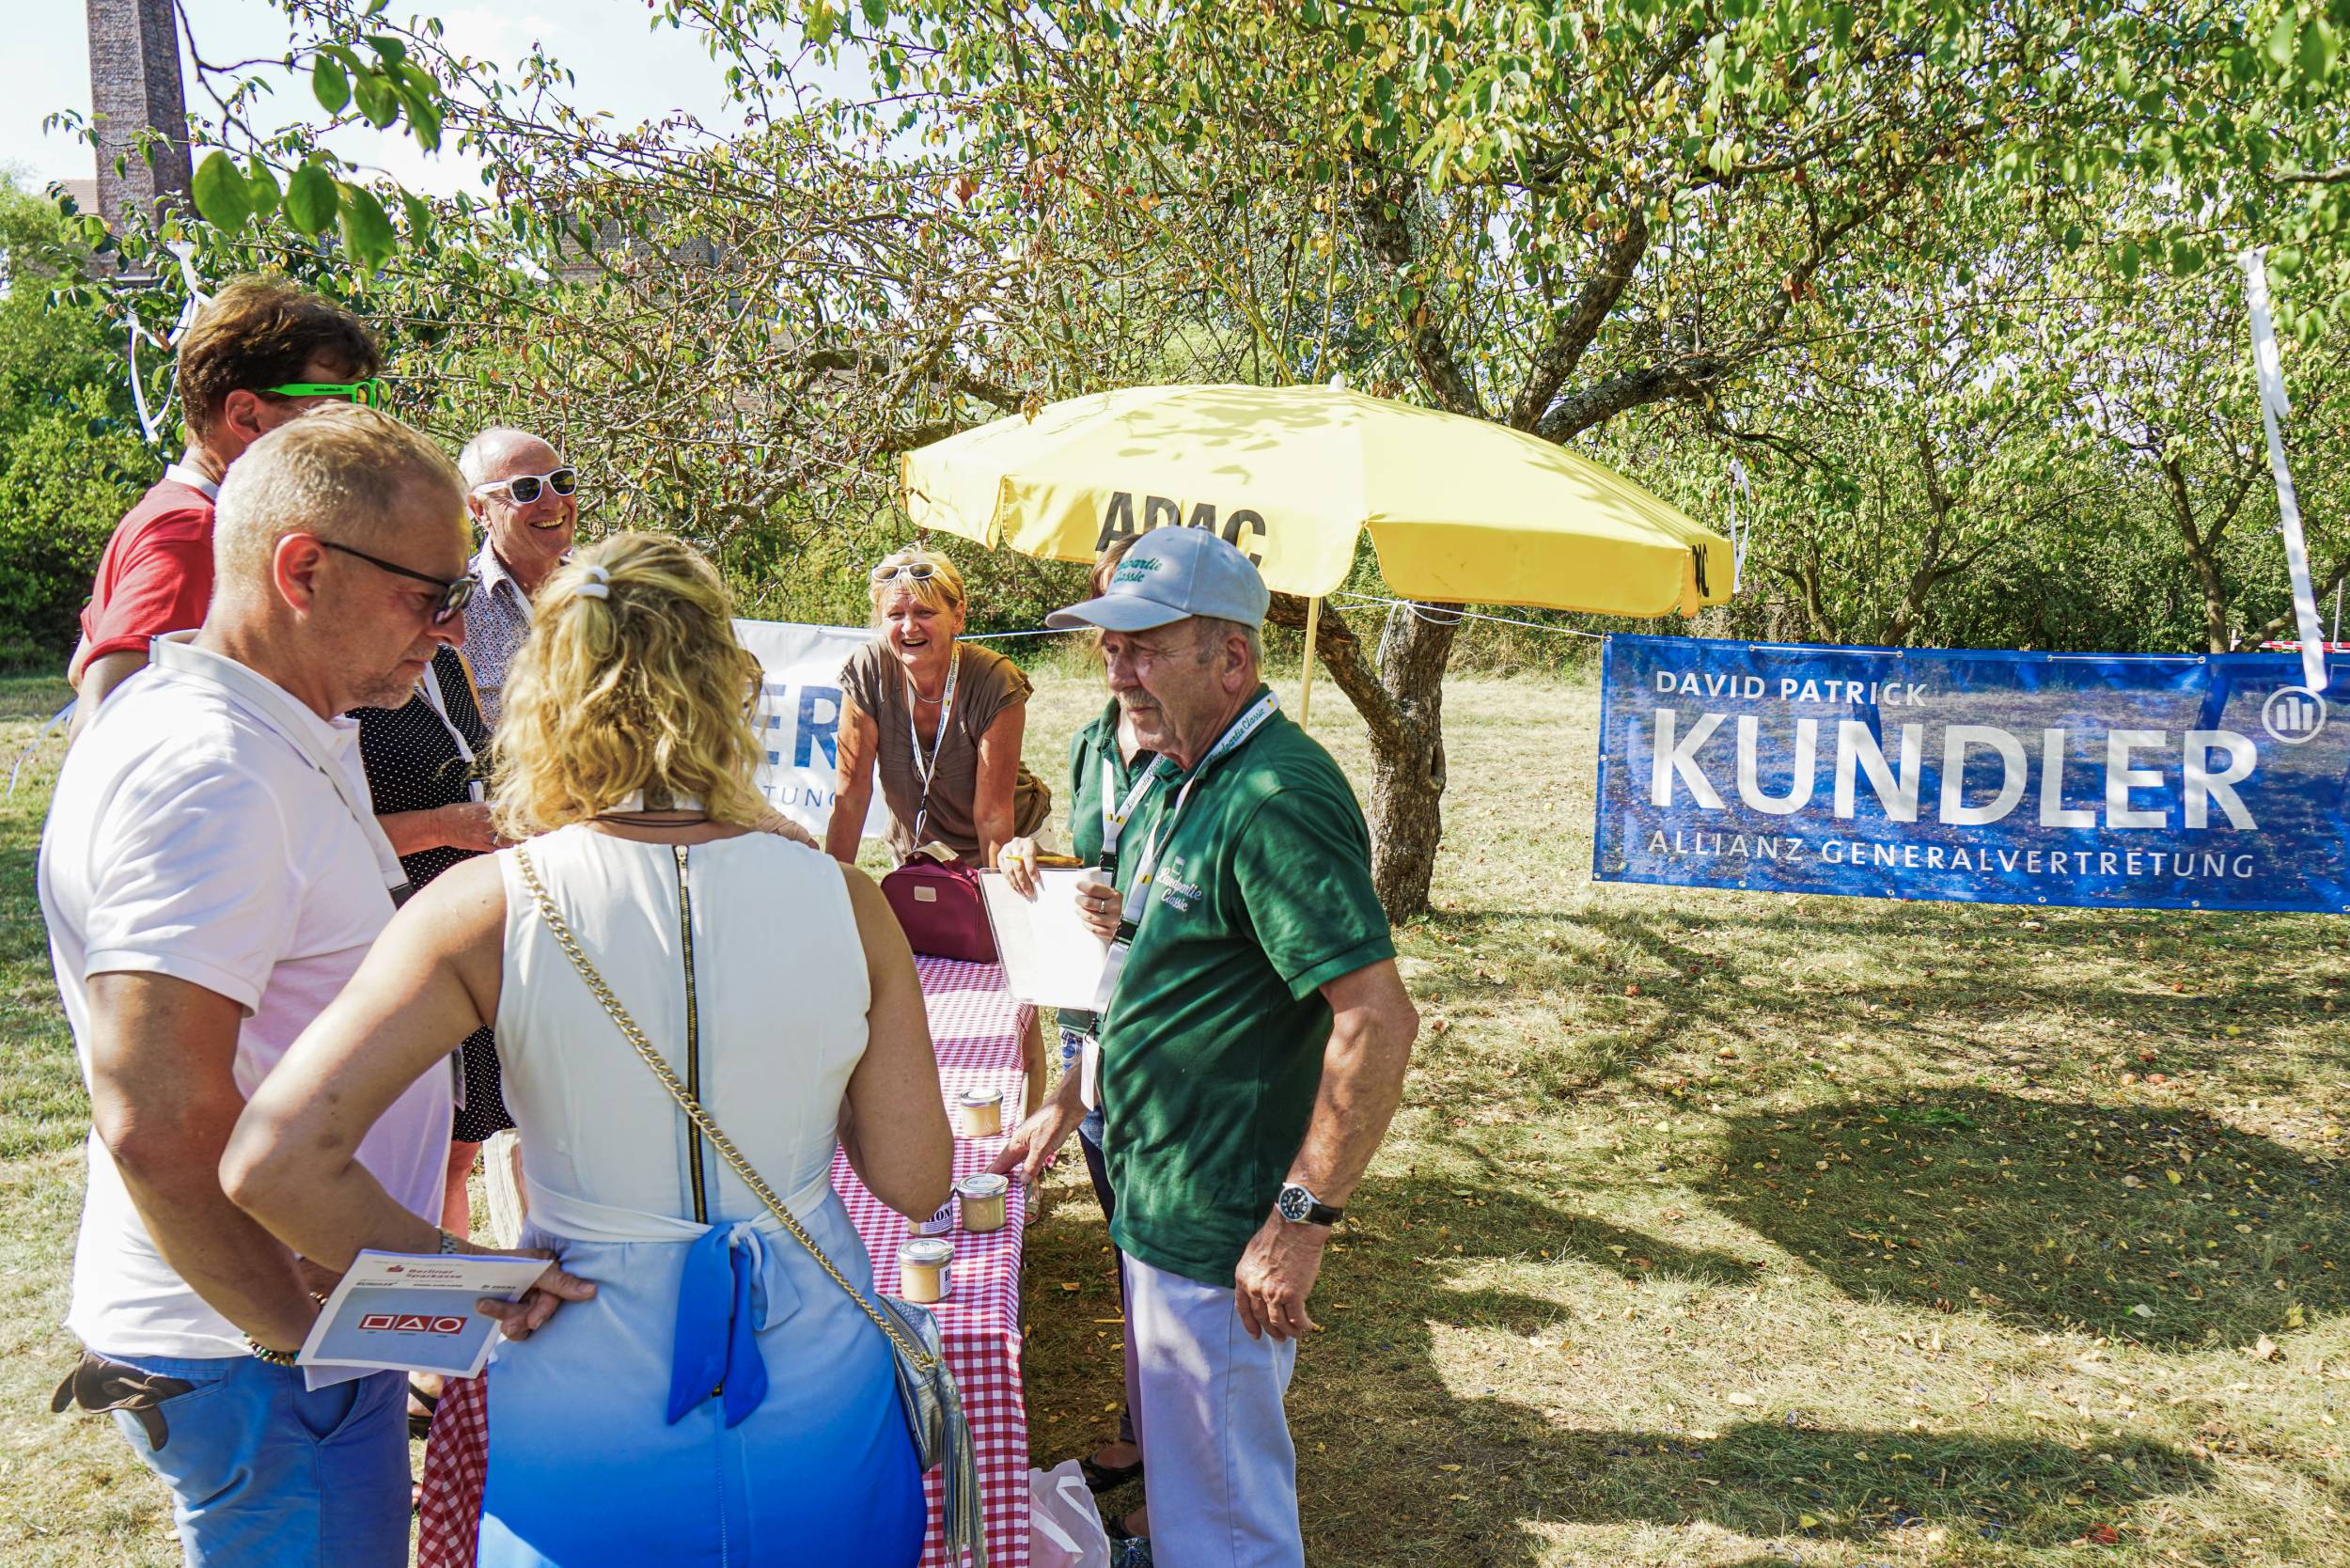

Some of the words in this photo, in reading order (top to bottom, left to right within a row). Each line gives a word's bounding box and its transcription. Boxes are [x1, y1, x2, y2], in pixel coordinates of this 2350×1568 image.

[1656, 670, 1765, 700] DAVID
[1779, 676, 1927, 708] PATRICK
[1242, 708, 1264, 730] Classic
[1651, 708, 2258, 831] KUNDLER
[1648, 831, 1802, 863] ALLIANZ
[1821, 840, 2254, 879] GENERALVERTRETUNG
[1161, 887, 1188, 912] Classic
